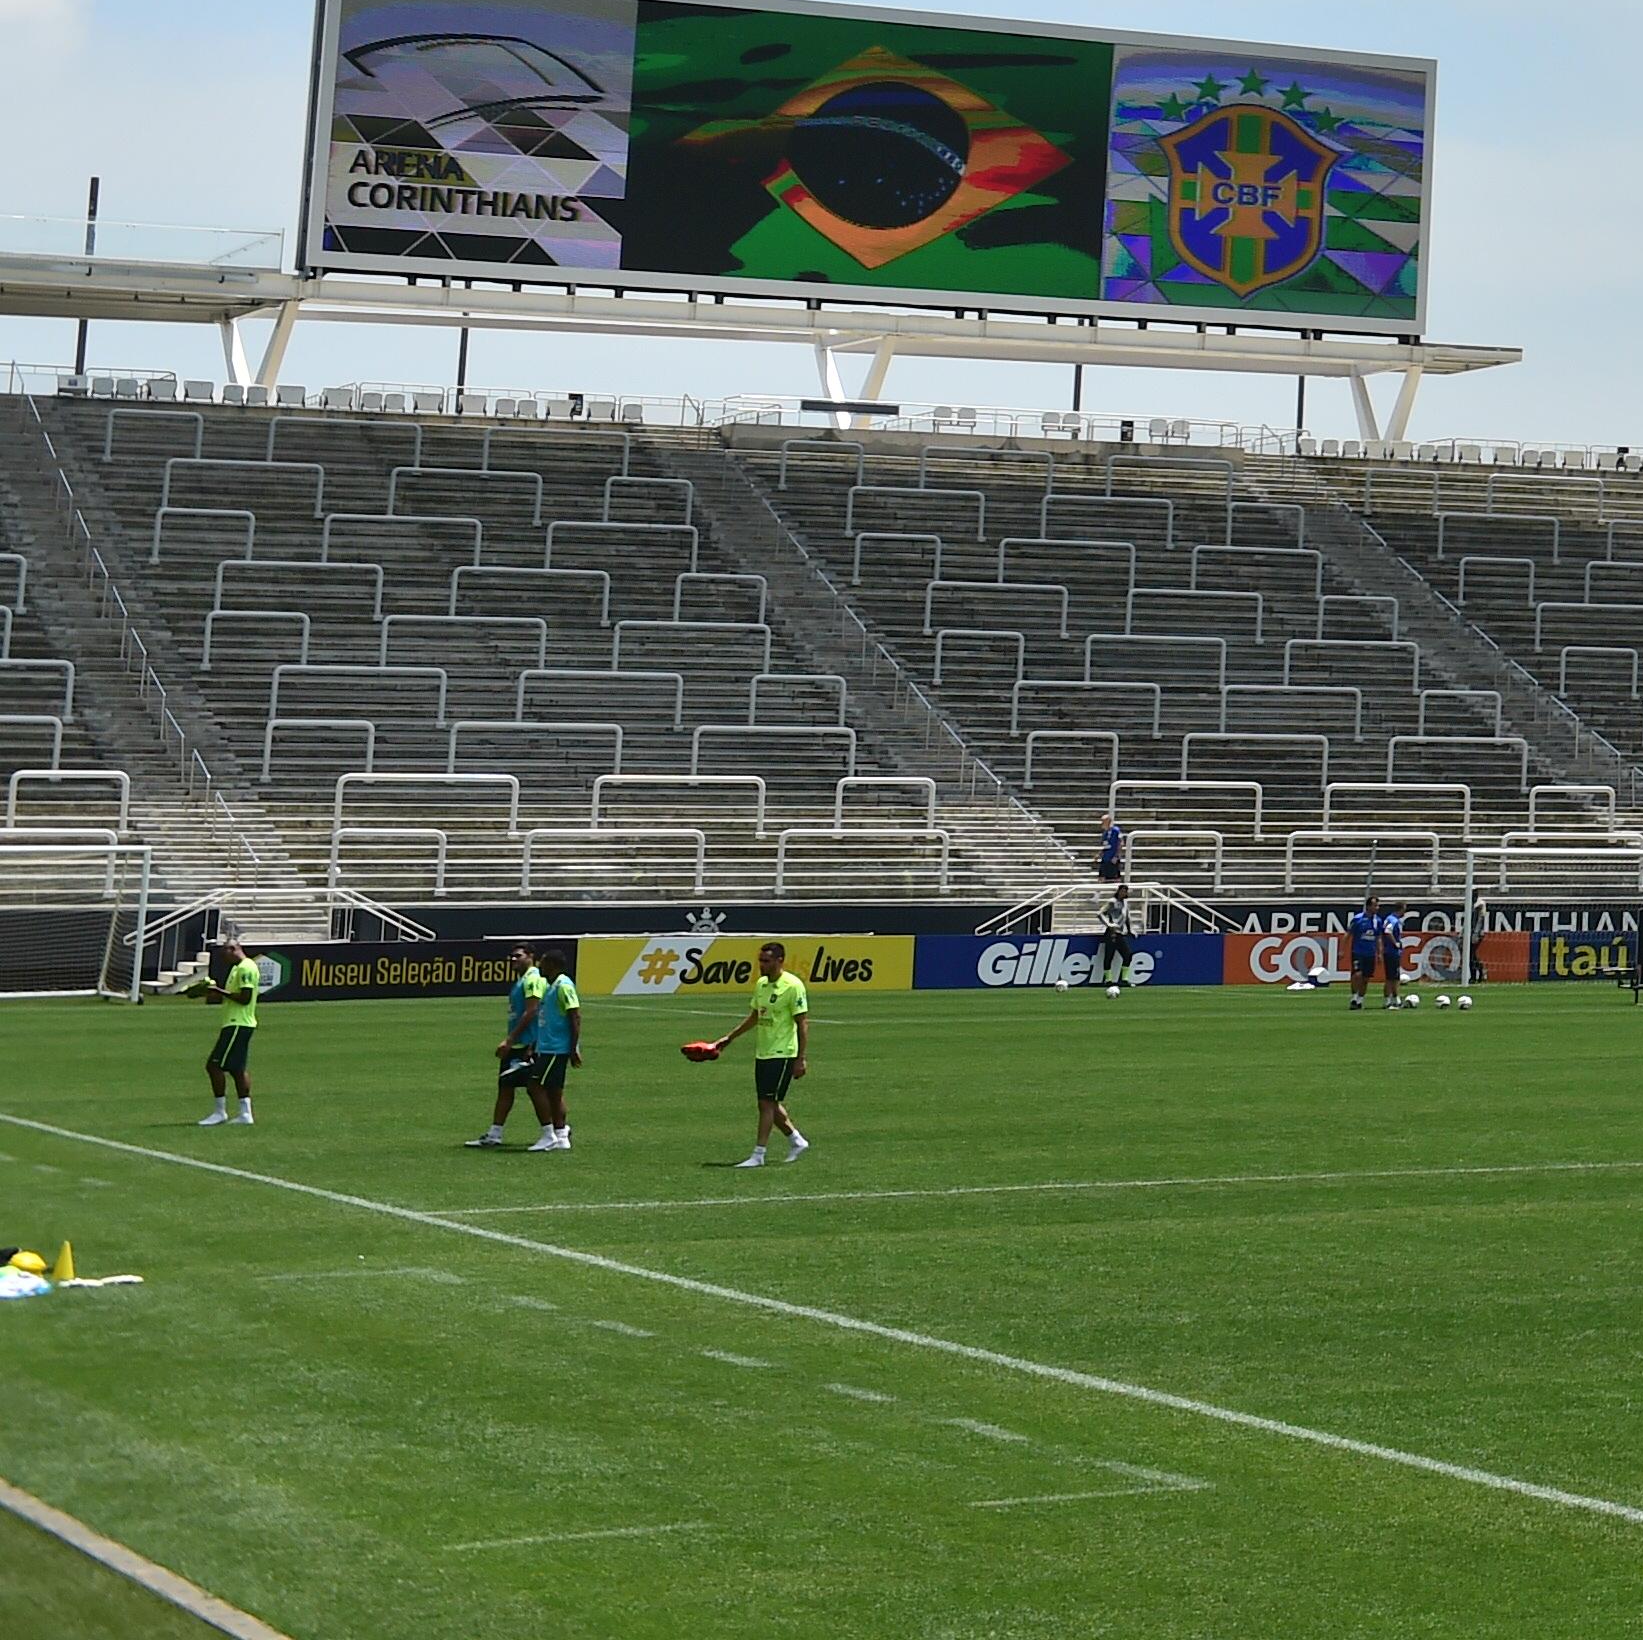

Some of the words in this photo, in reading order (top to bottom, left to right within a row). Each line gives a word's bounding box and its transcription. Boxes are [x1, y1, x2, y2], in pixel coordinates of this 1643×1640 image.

[349, 149, 465, 182] ARENA
[347, 181, 581, 222] CORINTHIANS
[1212, 182, 1282, 207] CBF
[1242, 912, 1351, 934] AREN
[301, 958, 371, 987] Museu
[376, 956, 455, 988] Seleção
[461, 956, 516, 984] Brasi
[1250, 936, 1351, 983] GOL
[1400, 936, 1463, 982] GO
[1538, 936, 1628, 977] Itaú
